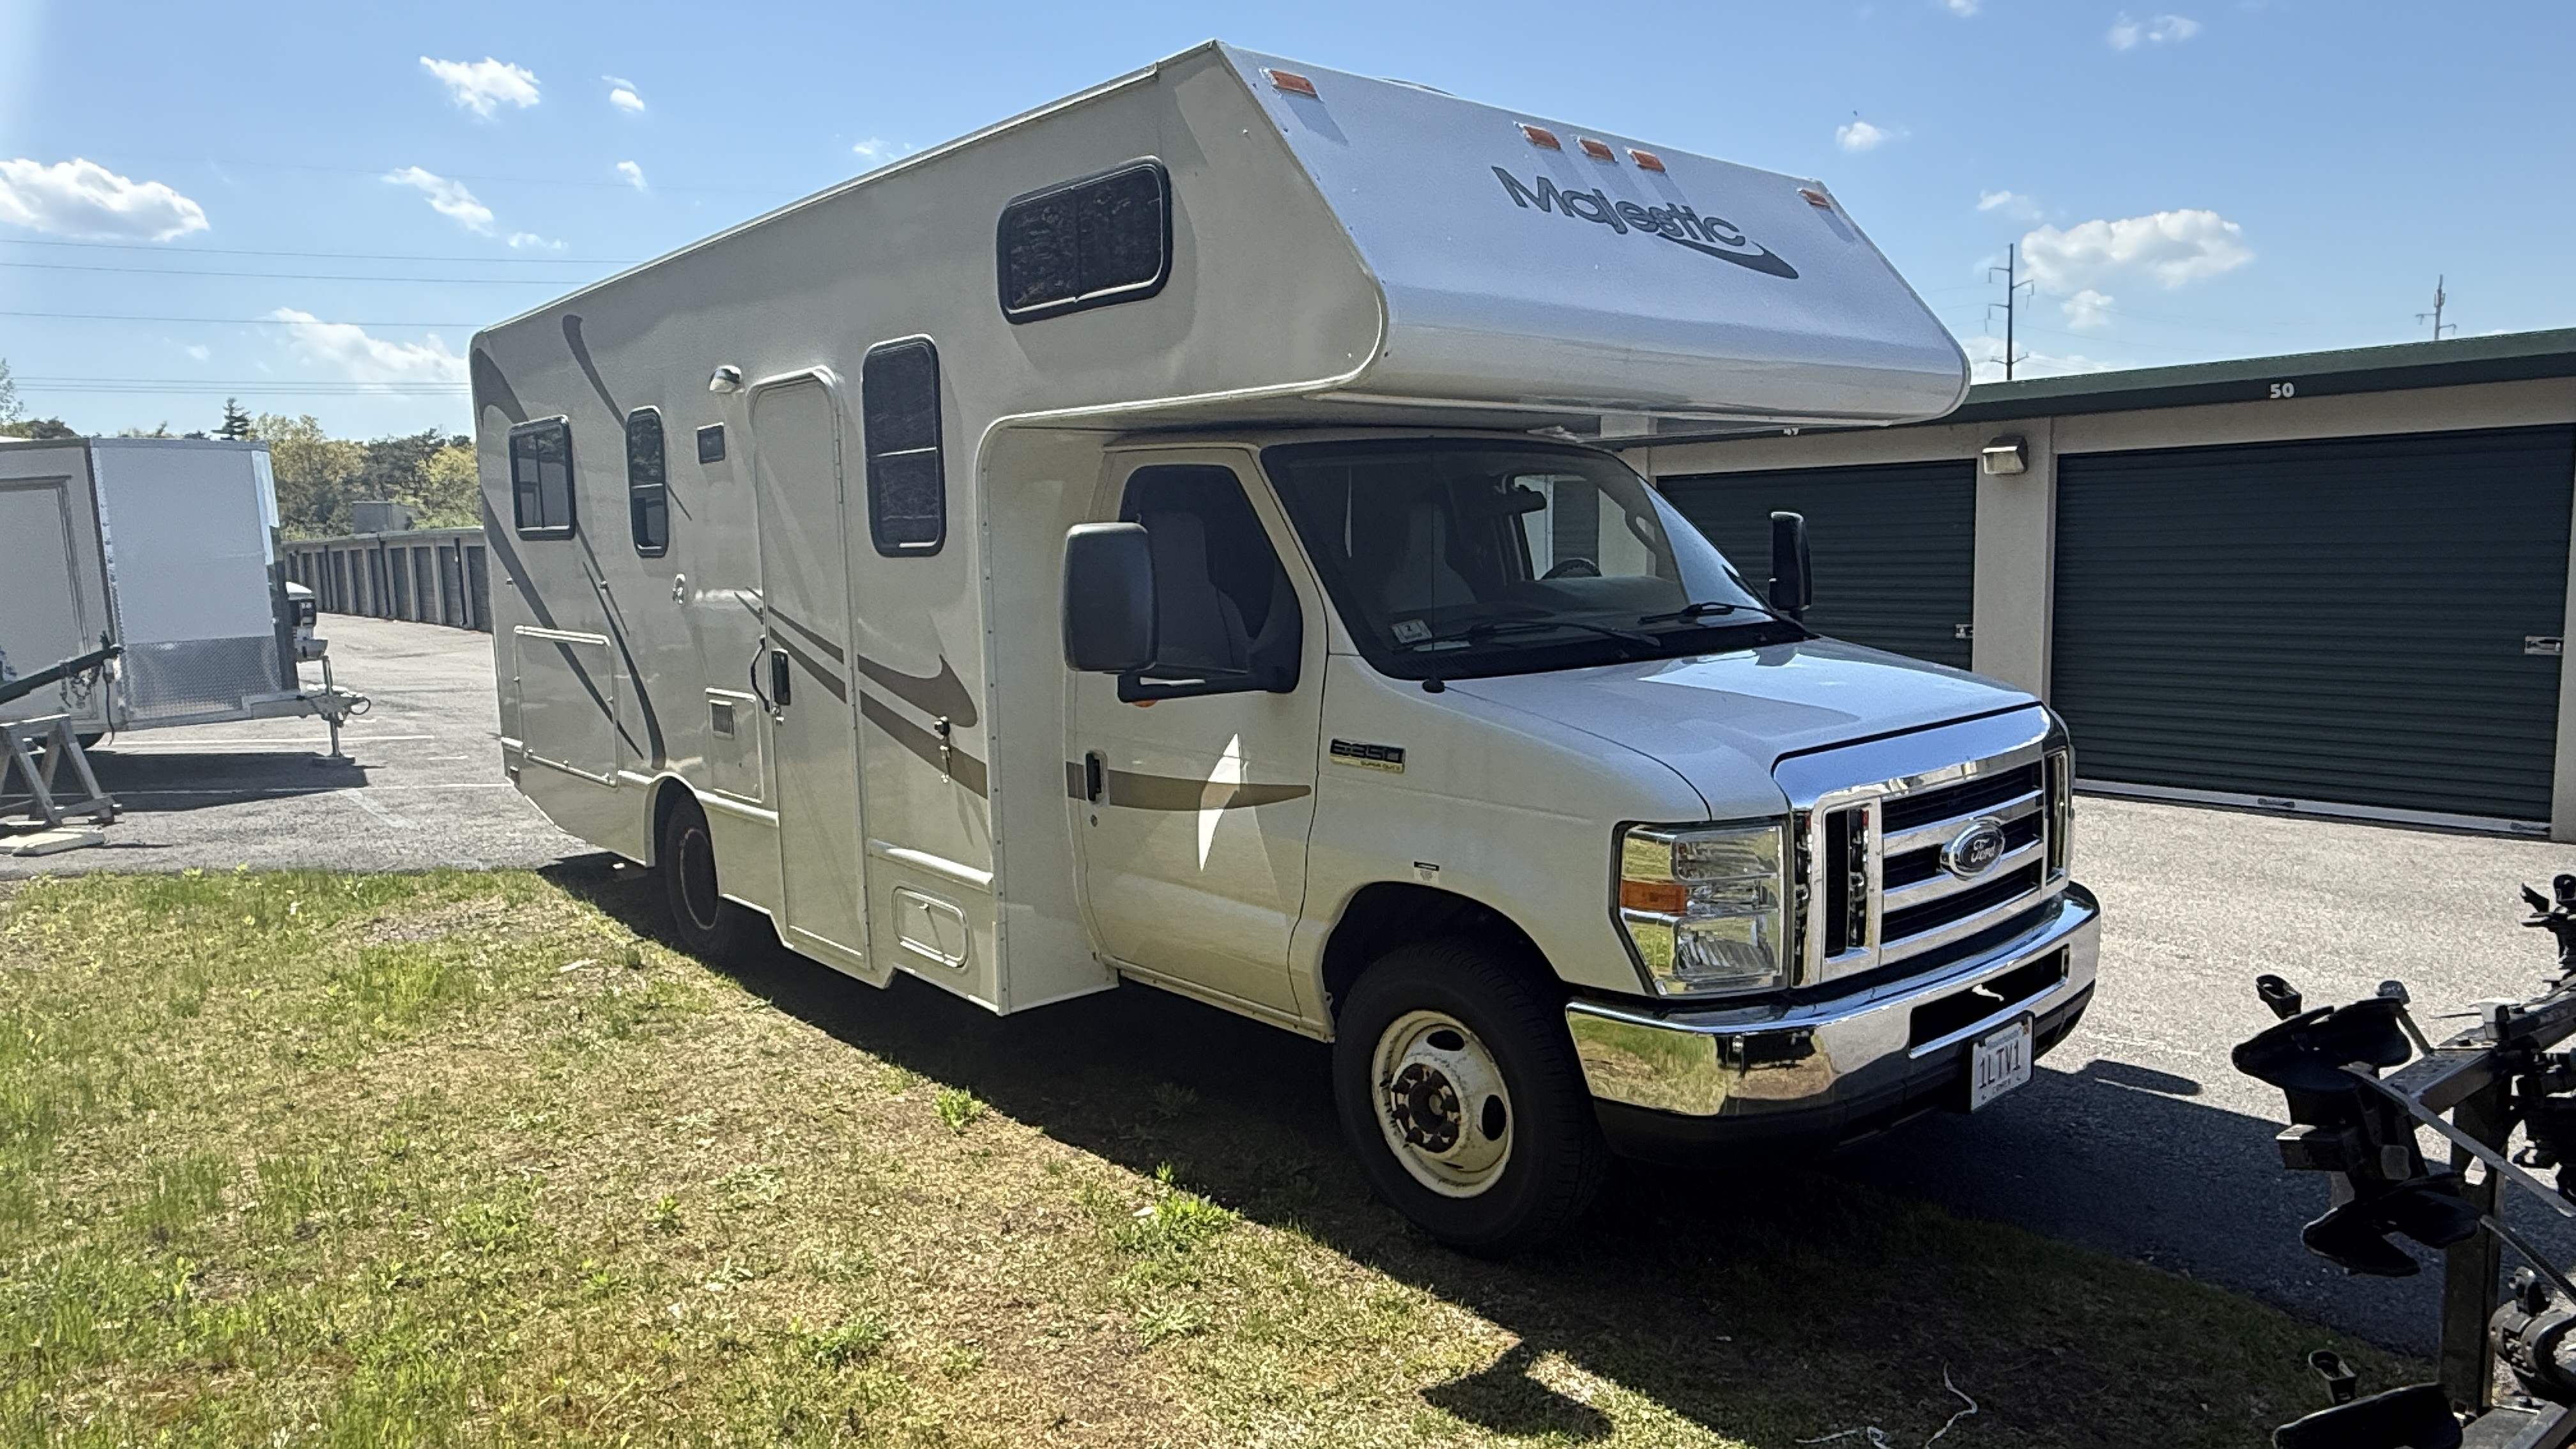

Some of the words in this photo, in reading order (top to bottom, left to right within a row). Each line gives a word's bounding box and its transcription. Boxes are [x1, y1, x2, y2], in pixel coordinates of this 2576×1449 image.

[1491, 165, 1745, 246] Majestic
[2269, 382, 2295, 399] 50
[1970, 838, 1997, 863] Ford
[1979, 1039, 2021, 1090] 1LTV1
